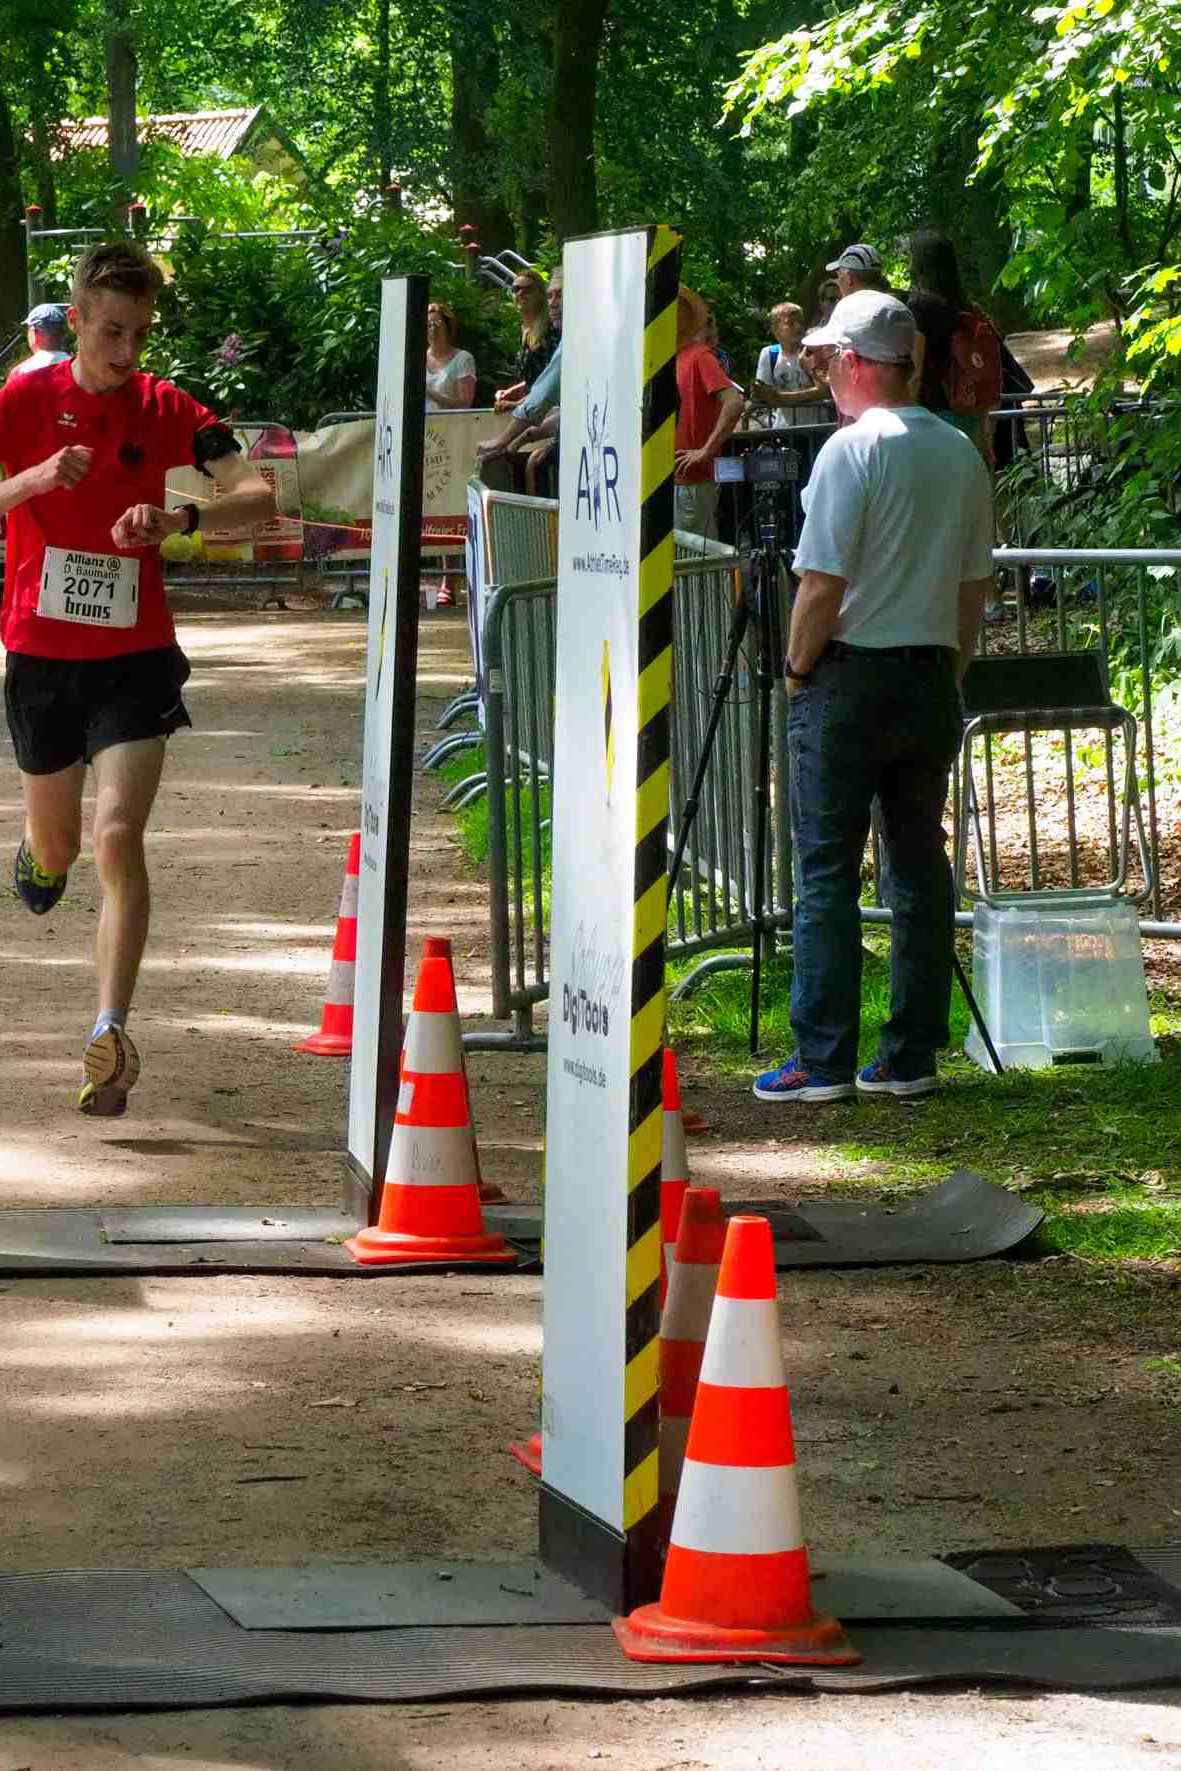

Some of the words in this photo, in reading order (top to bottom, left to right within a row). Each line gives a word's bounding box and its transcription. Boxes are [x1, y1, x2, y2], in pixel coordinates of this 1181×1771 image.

[65, 553, 105, 567] Allianz
[76, 566, 120, 580] Baumann
[63, 577, 115, 599] 2071
[65, 596, 111, 620] bruns
